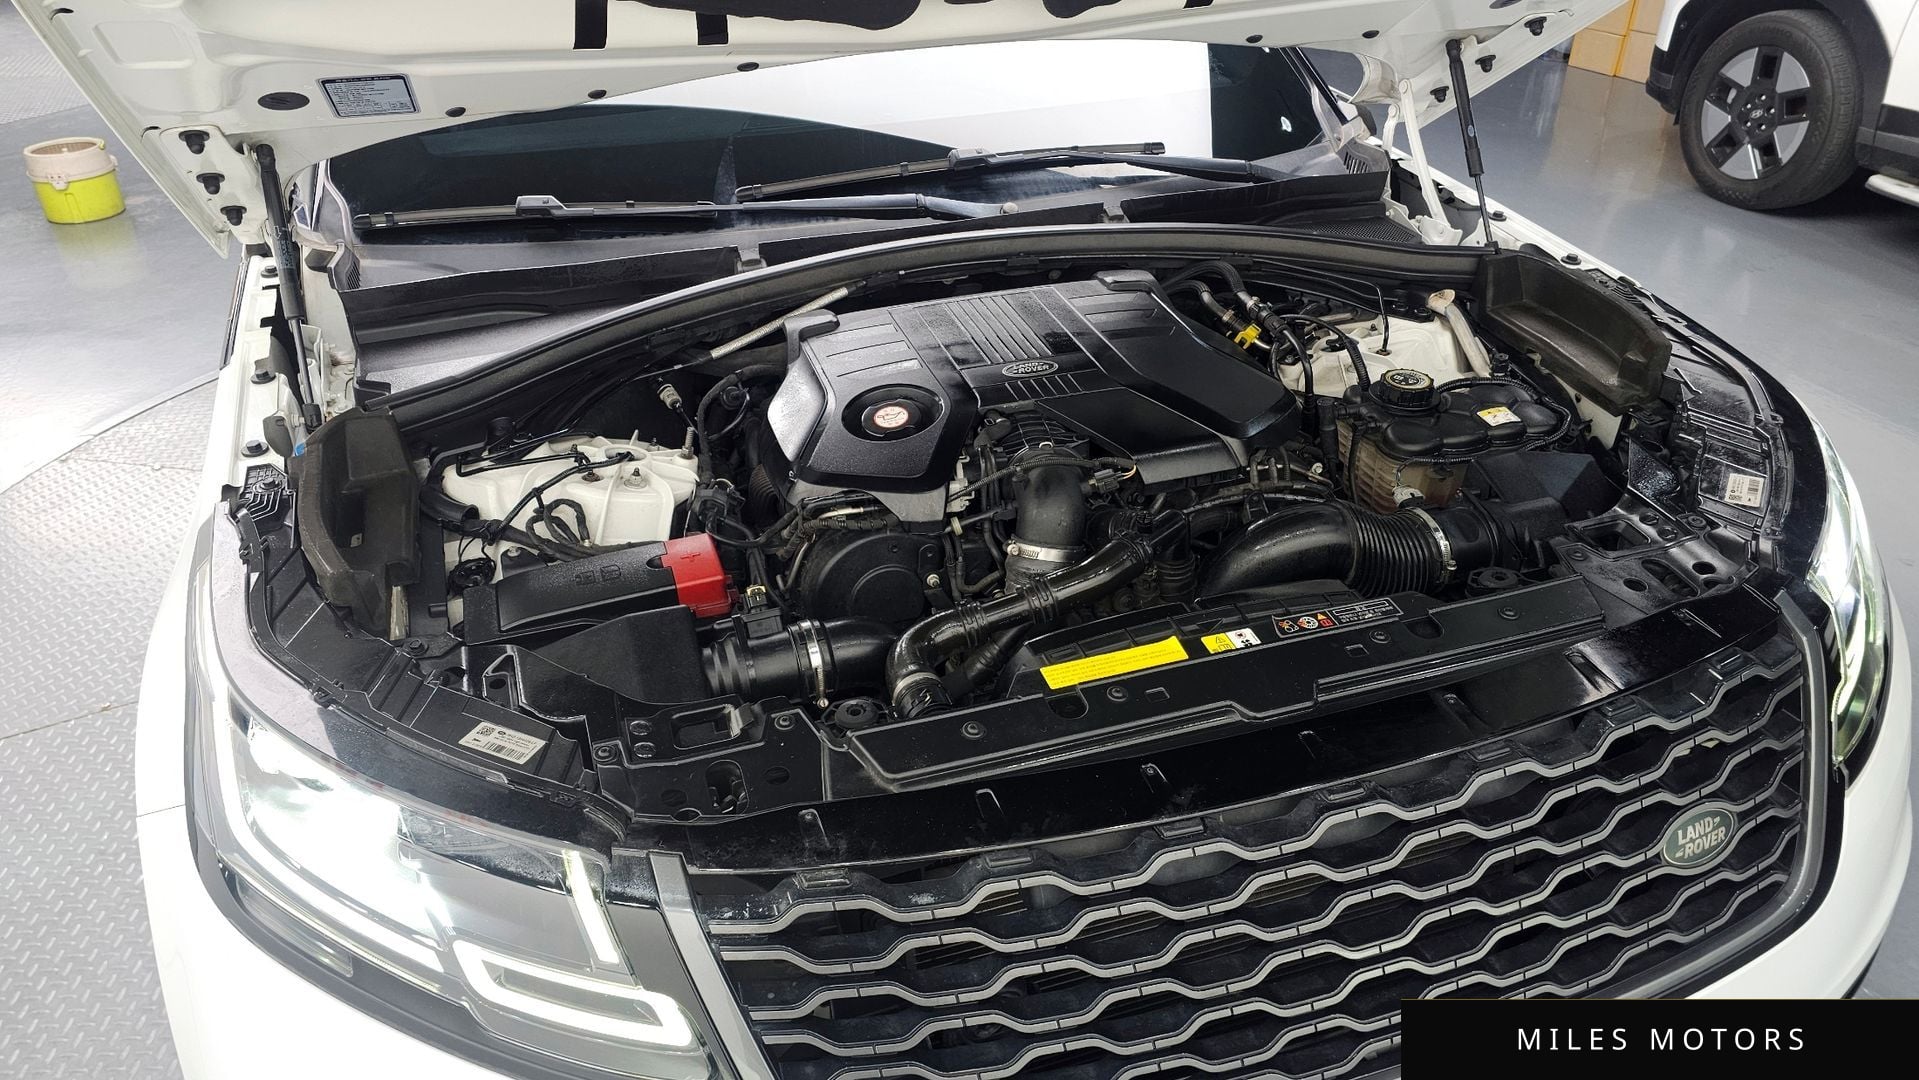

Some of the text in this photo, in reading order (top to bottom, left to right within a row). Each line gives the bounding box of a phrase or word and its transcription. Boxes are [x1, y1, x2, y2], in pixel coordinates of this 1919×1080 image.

[1013, 362, 1039, 370] LAND
[1018, 365, 1049, 373] ROVER
[1677, 817, 1713, 845] LAND
[1684, 826, 1726, 859] ROVER
